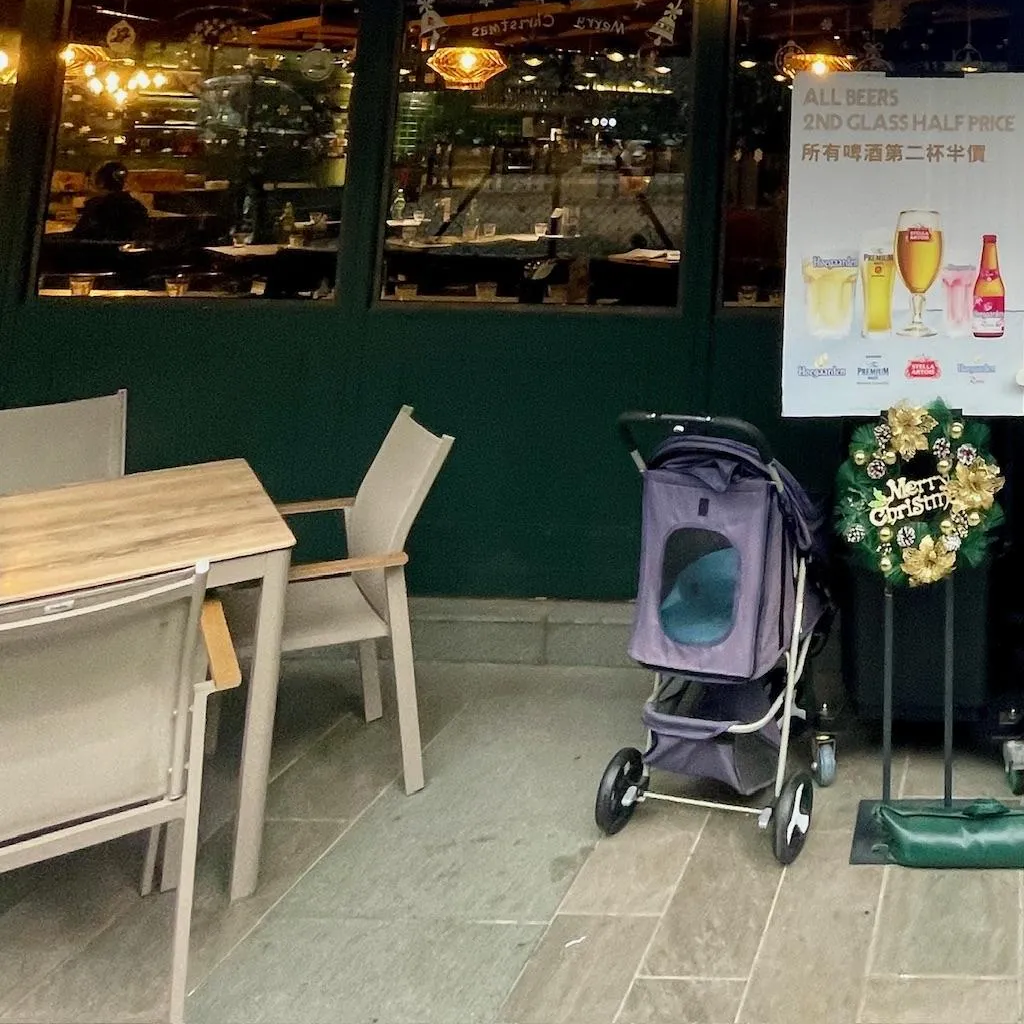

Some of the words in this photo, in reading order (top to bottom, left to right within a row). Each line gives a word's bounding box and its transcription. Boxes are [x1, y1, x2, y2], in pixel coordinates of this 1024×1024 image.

[803, 87, 841, 106] ALL
[846, 88, 899, 107] BEERS
[803, 113, 843, 131] 2ND
[847, 113, 908, 132] GLASS
[912, 114, 965, 132] HALF
[968, 115, 1016, 133] PRICE
[801, 142, 986, 163] 所有啤酒第二杯半價
